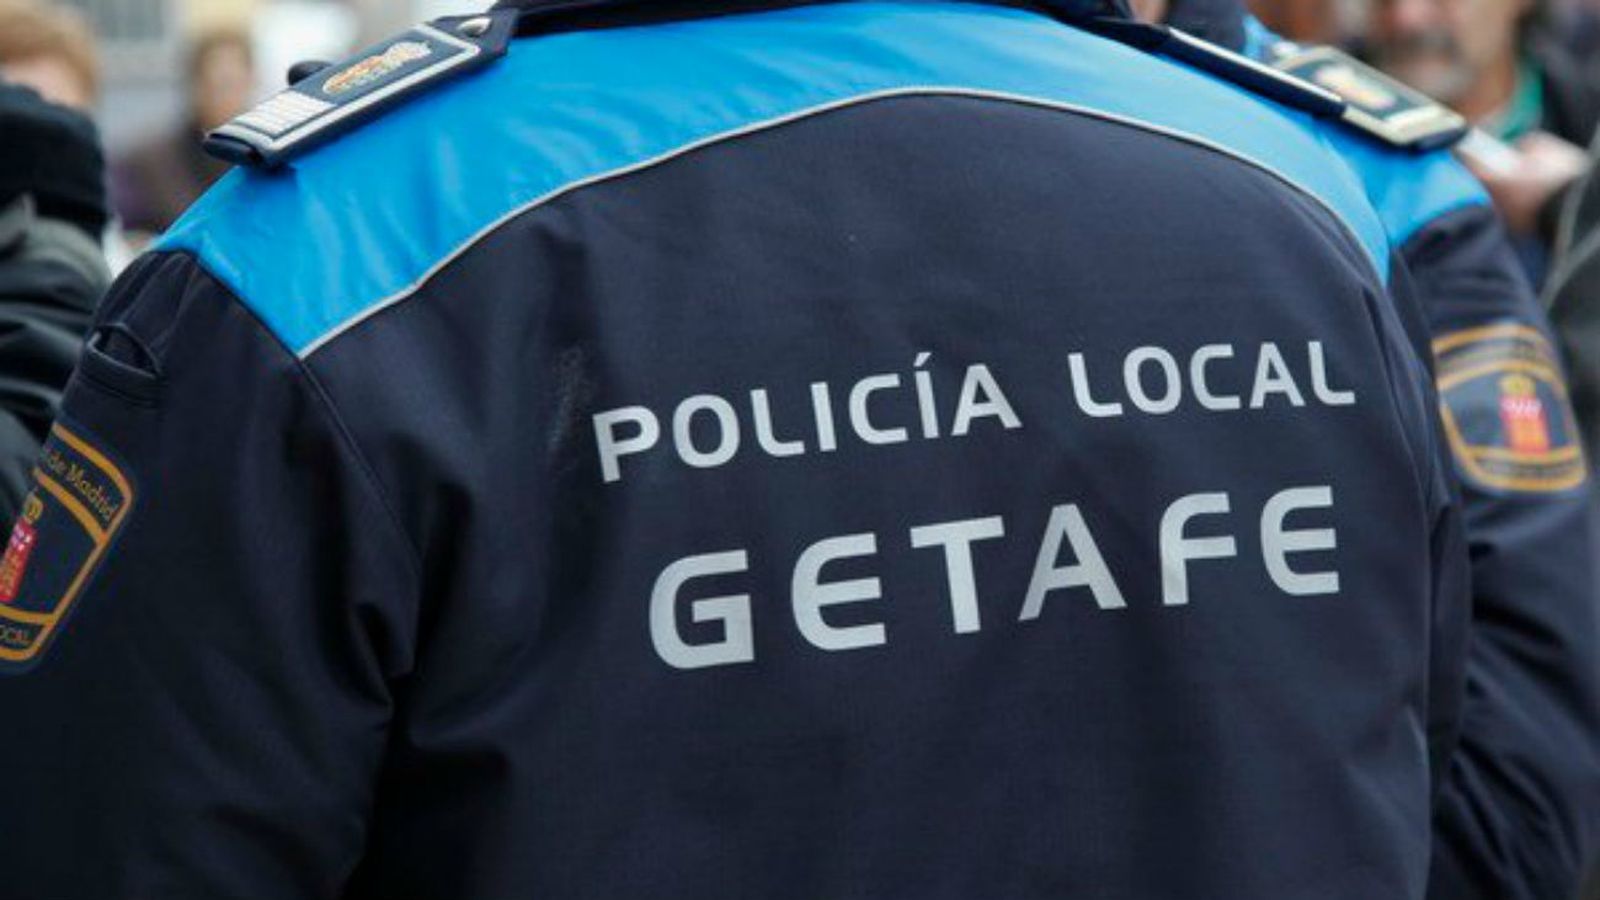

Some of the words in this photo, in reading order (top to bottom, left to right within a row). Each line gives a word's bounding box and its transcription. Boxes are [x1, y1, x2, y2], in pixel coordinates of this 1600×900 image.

[592, 351, 1022, 482] POLICÍA
[1067, 340, 1356, 418] LOCAL
[63, 462, 119, 521] Madrid
[649, 485, 1340, 669] GETAFE
[0, 624, 33, 645] OCAL
